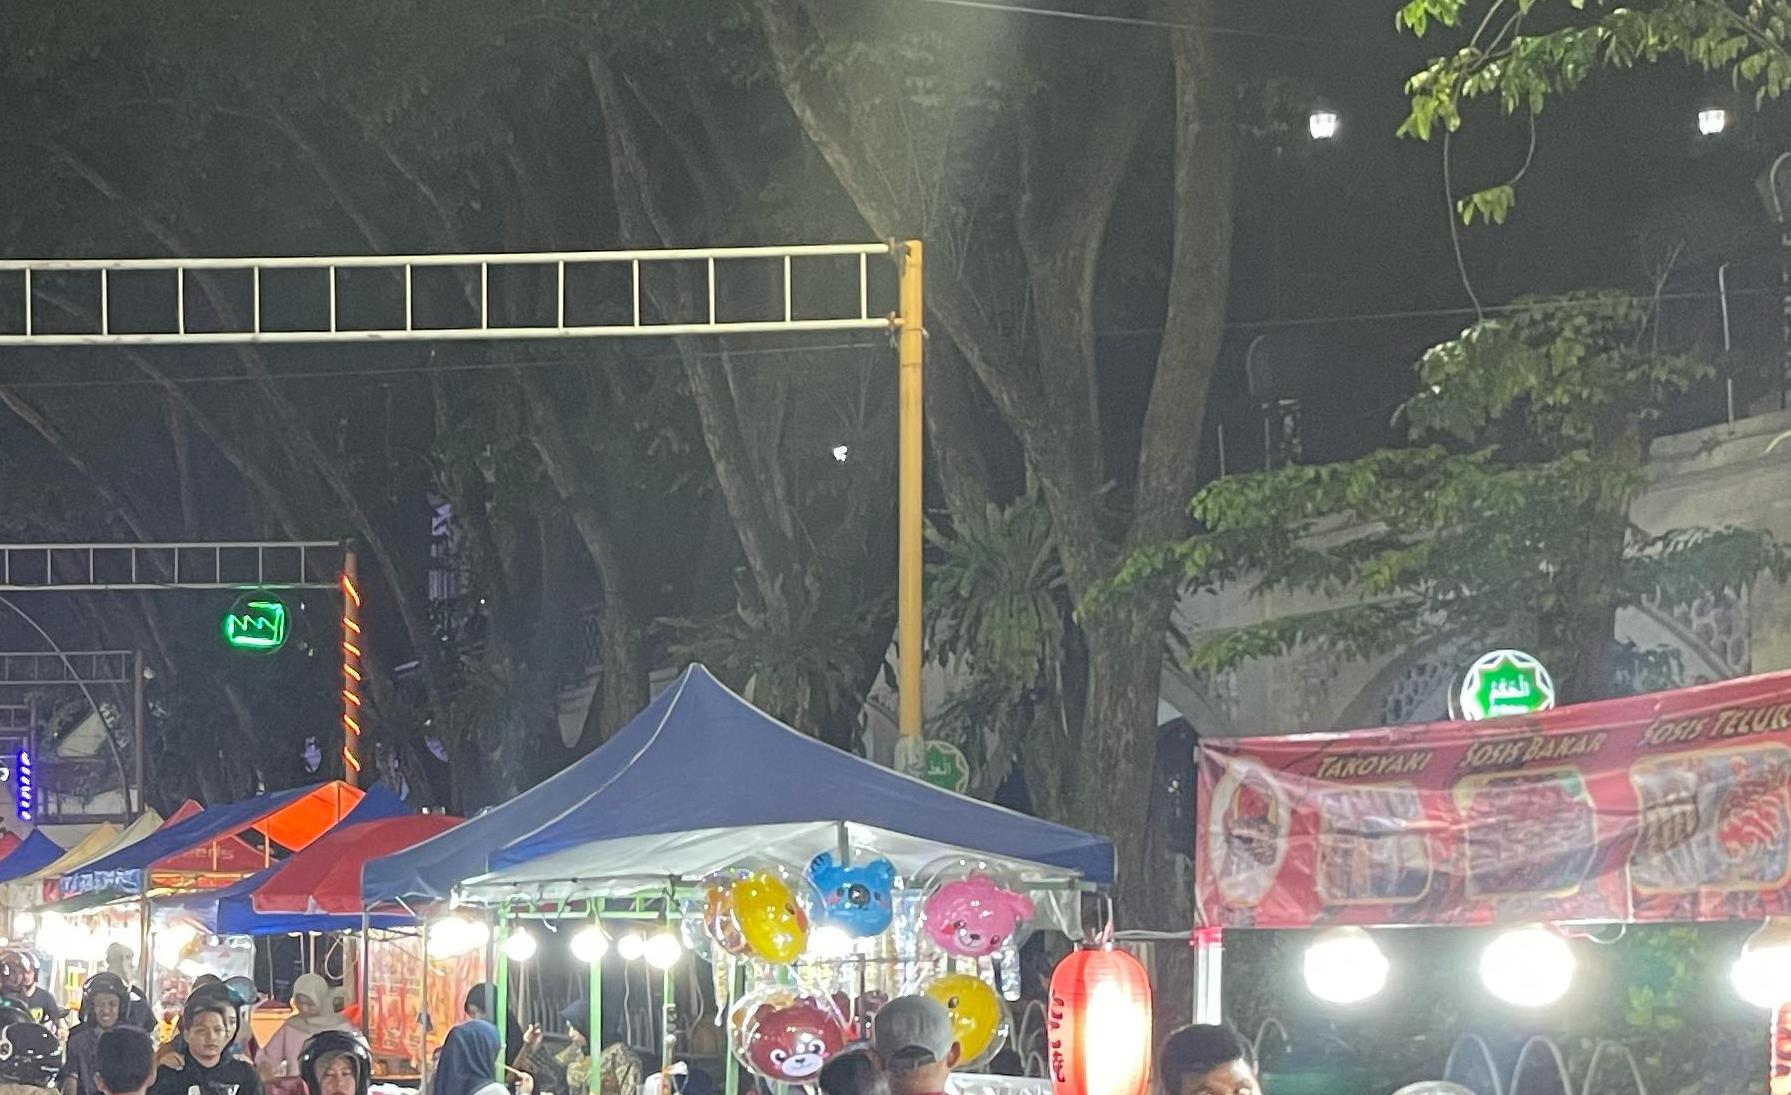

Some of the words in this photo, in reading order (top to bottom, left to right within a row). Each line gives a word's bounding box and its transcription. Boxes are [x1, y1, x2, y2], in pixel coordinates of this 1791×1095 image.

[1638, 717, 1709, 747] SOSIS
[1316, 752, 1434, 778] TAKOYAKI
[1461, 741, 1527, 767] SOSIS
[1524, 733, 1608, 760] BAKAR
